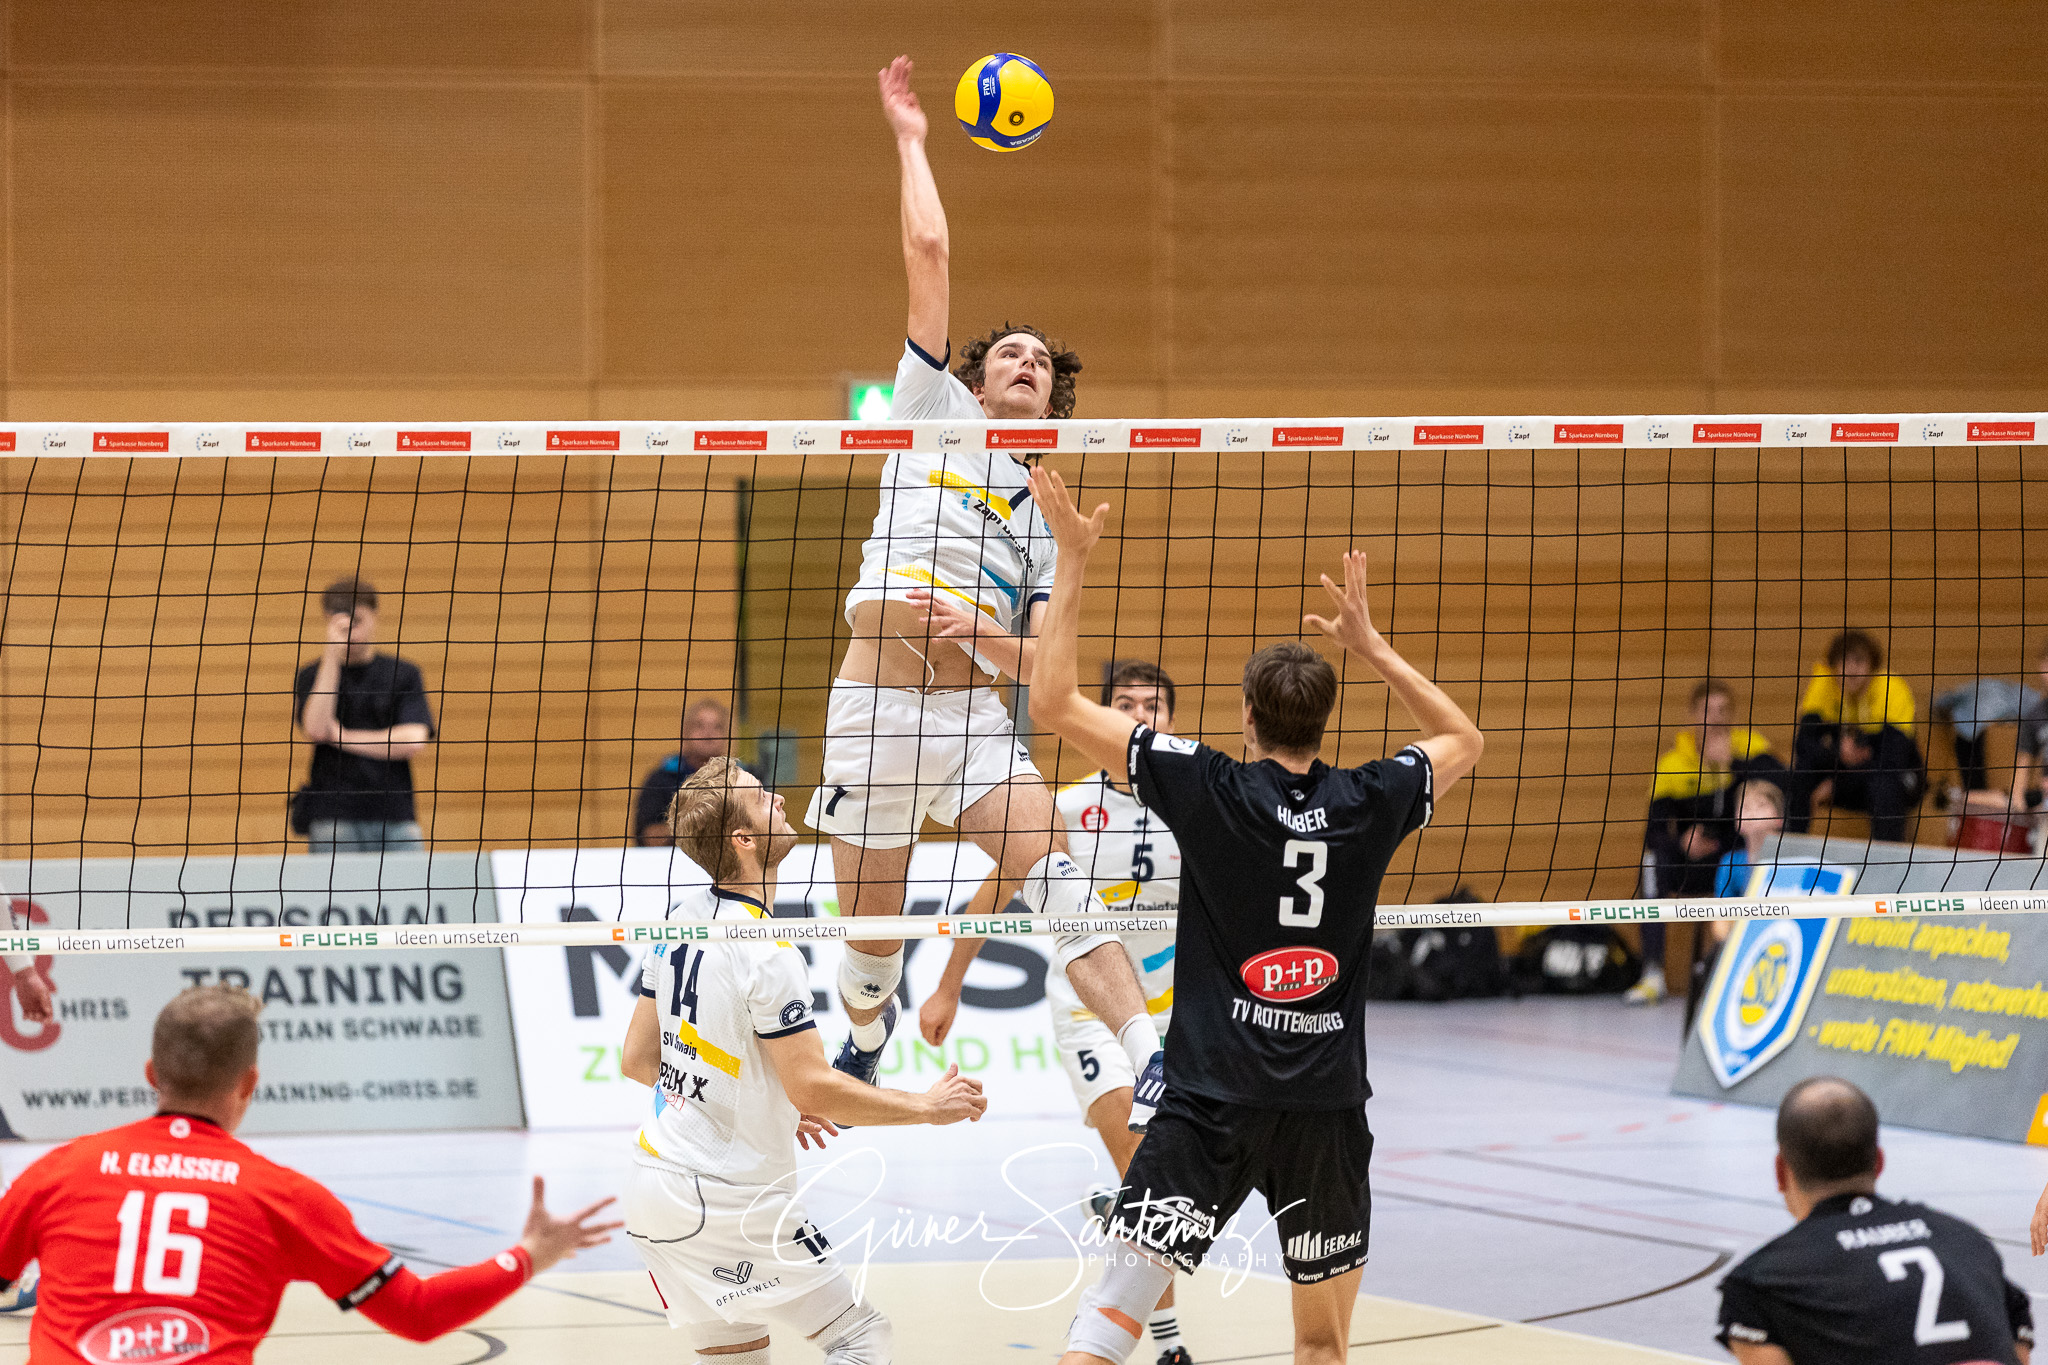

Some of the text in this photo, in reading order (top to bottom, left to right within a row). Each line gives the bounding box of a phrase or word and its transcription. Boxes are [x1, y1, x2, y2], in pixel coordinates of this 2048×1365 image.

[982, 77, 991, 96] FIVB
[799, 438, 815, 447] Zapf
[945, 437, 961, 446] Zapf
[1089, 437, 1105, 445] Zapf
[1232, 436, 1248, 444] Zapf
[1373, 434, 1389, 442] Zapf
[1514, 433, 1530, 441] Zapf
[1653, 432, 1669, 440] Zapf
[1792, 431, 1807, 439] Zapf
[1928, 430, 1944, 438] Zapf
[49, 440, 66, 449] Zapf
[202, 440, 219, 449] Zapf
[354, 440, 371, 449] Zapf
[504, 439, 520, 448] Zapf
[652, 439, 669, 448] Zapf
[1277, 804, 1328, 833] HUBER
[1131, 843, 1155, 883] 5
[1279, 839, 1328, 928] 3
[1590, 903, 1790, 920] FUCHS Ideen umsetzen
[1896, 898, 1965, 912] FUCHS
[1979, 896, 2019, 911] Ideen
[960, 917, 1168, 934] FUCHS Ideen umsetzen
[1373, 910, 1482, 926] deen umsetzen
[302, 930, 519, 947] FUCHS Ideen umsetzen
[634, 925, 847, 941] FUCHS Ideen umsetzen
[0, 934, 185, 951] CHS Ideen umsetzen
[669, 942, 705, 1025] 14
[1262, 957, 1324, 993] p+p
[1232, 997, 1344, 1034] TV ROTTENBURG
[342, 1014, 482, 1041] SCHWADE
[663, 1031, 675, 1047] SV
[1078, 1049, 1100, 1083] 5
[100, 1151, 240, 1185] H. ELSÄSSER
[113, 1189, 209, 1298] 16
[1324, 1230, 1362, 1256] FERAL
[1297, 1271, 1324, 1282] Kempa
[1330, 1263, 1351, 1276] Kempa
[716, 1276, 781, 1307] OFFICEWELT
[1877, 1246, 1971, 1347] 2
[108, 1318, 189, 1360] p+p
